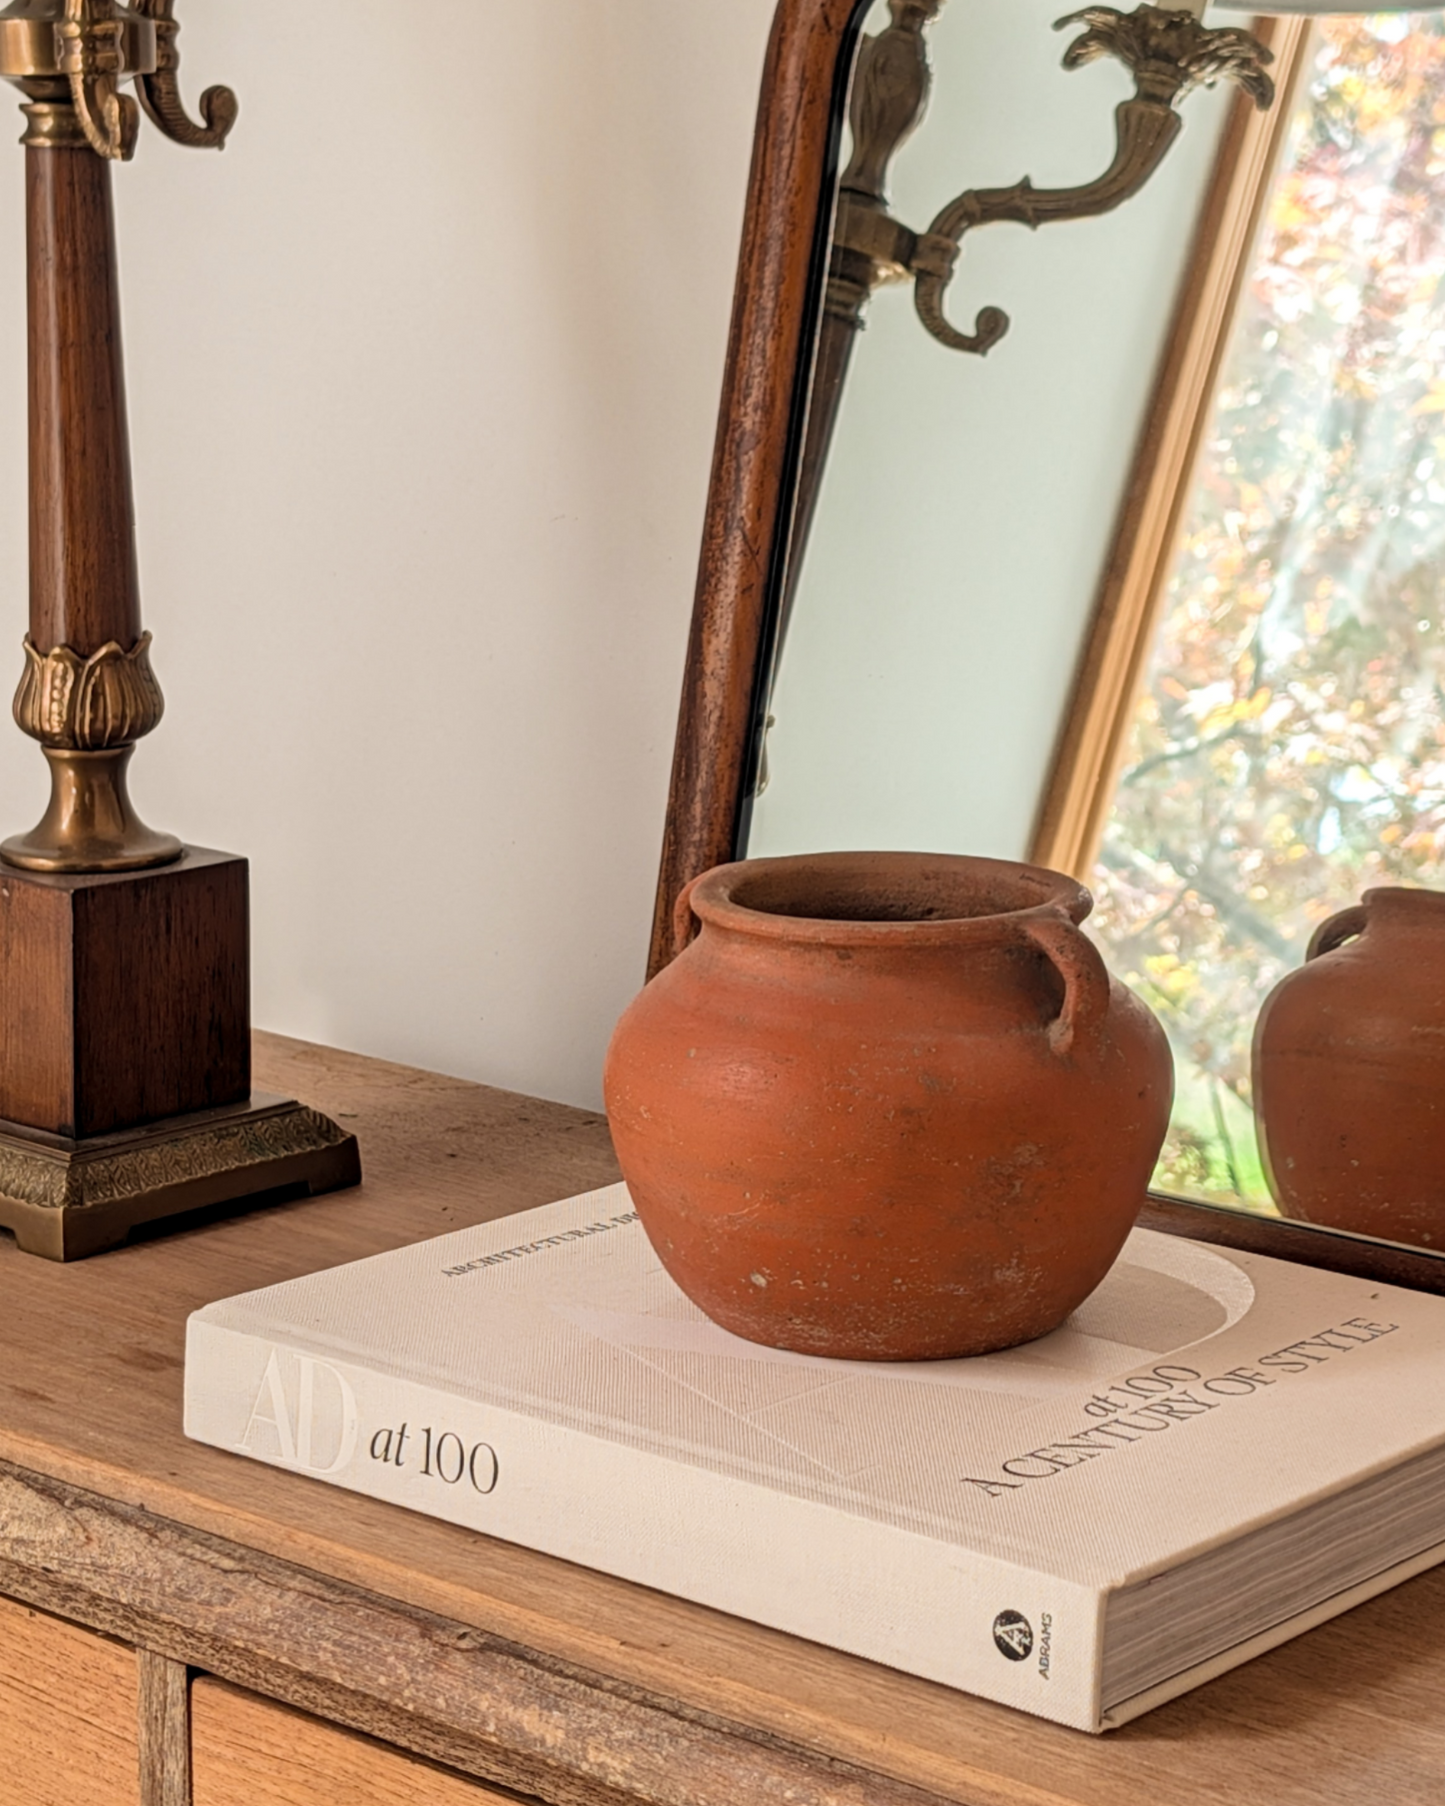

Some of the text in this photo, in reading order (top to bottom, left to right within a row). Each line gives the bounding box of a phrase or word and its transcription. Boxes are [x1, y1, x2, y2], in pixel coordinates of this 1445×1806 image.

[441, 1221, 617, 1278] ARCHITECTURAL
[234, 1347, 499, 1495] AD at 100
[960, 1317, 1400, 1497] A CENTURY OF STYLE
[1083, 1365, 1202, 1418] at 100
[1038, 1612, 1052, 1681] ABRAMS
